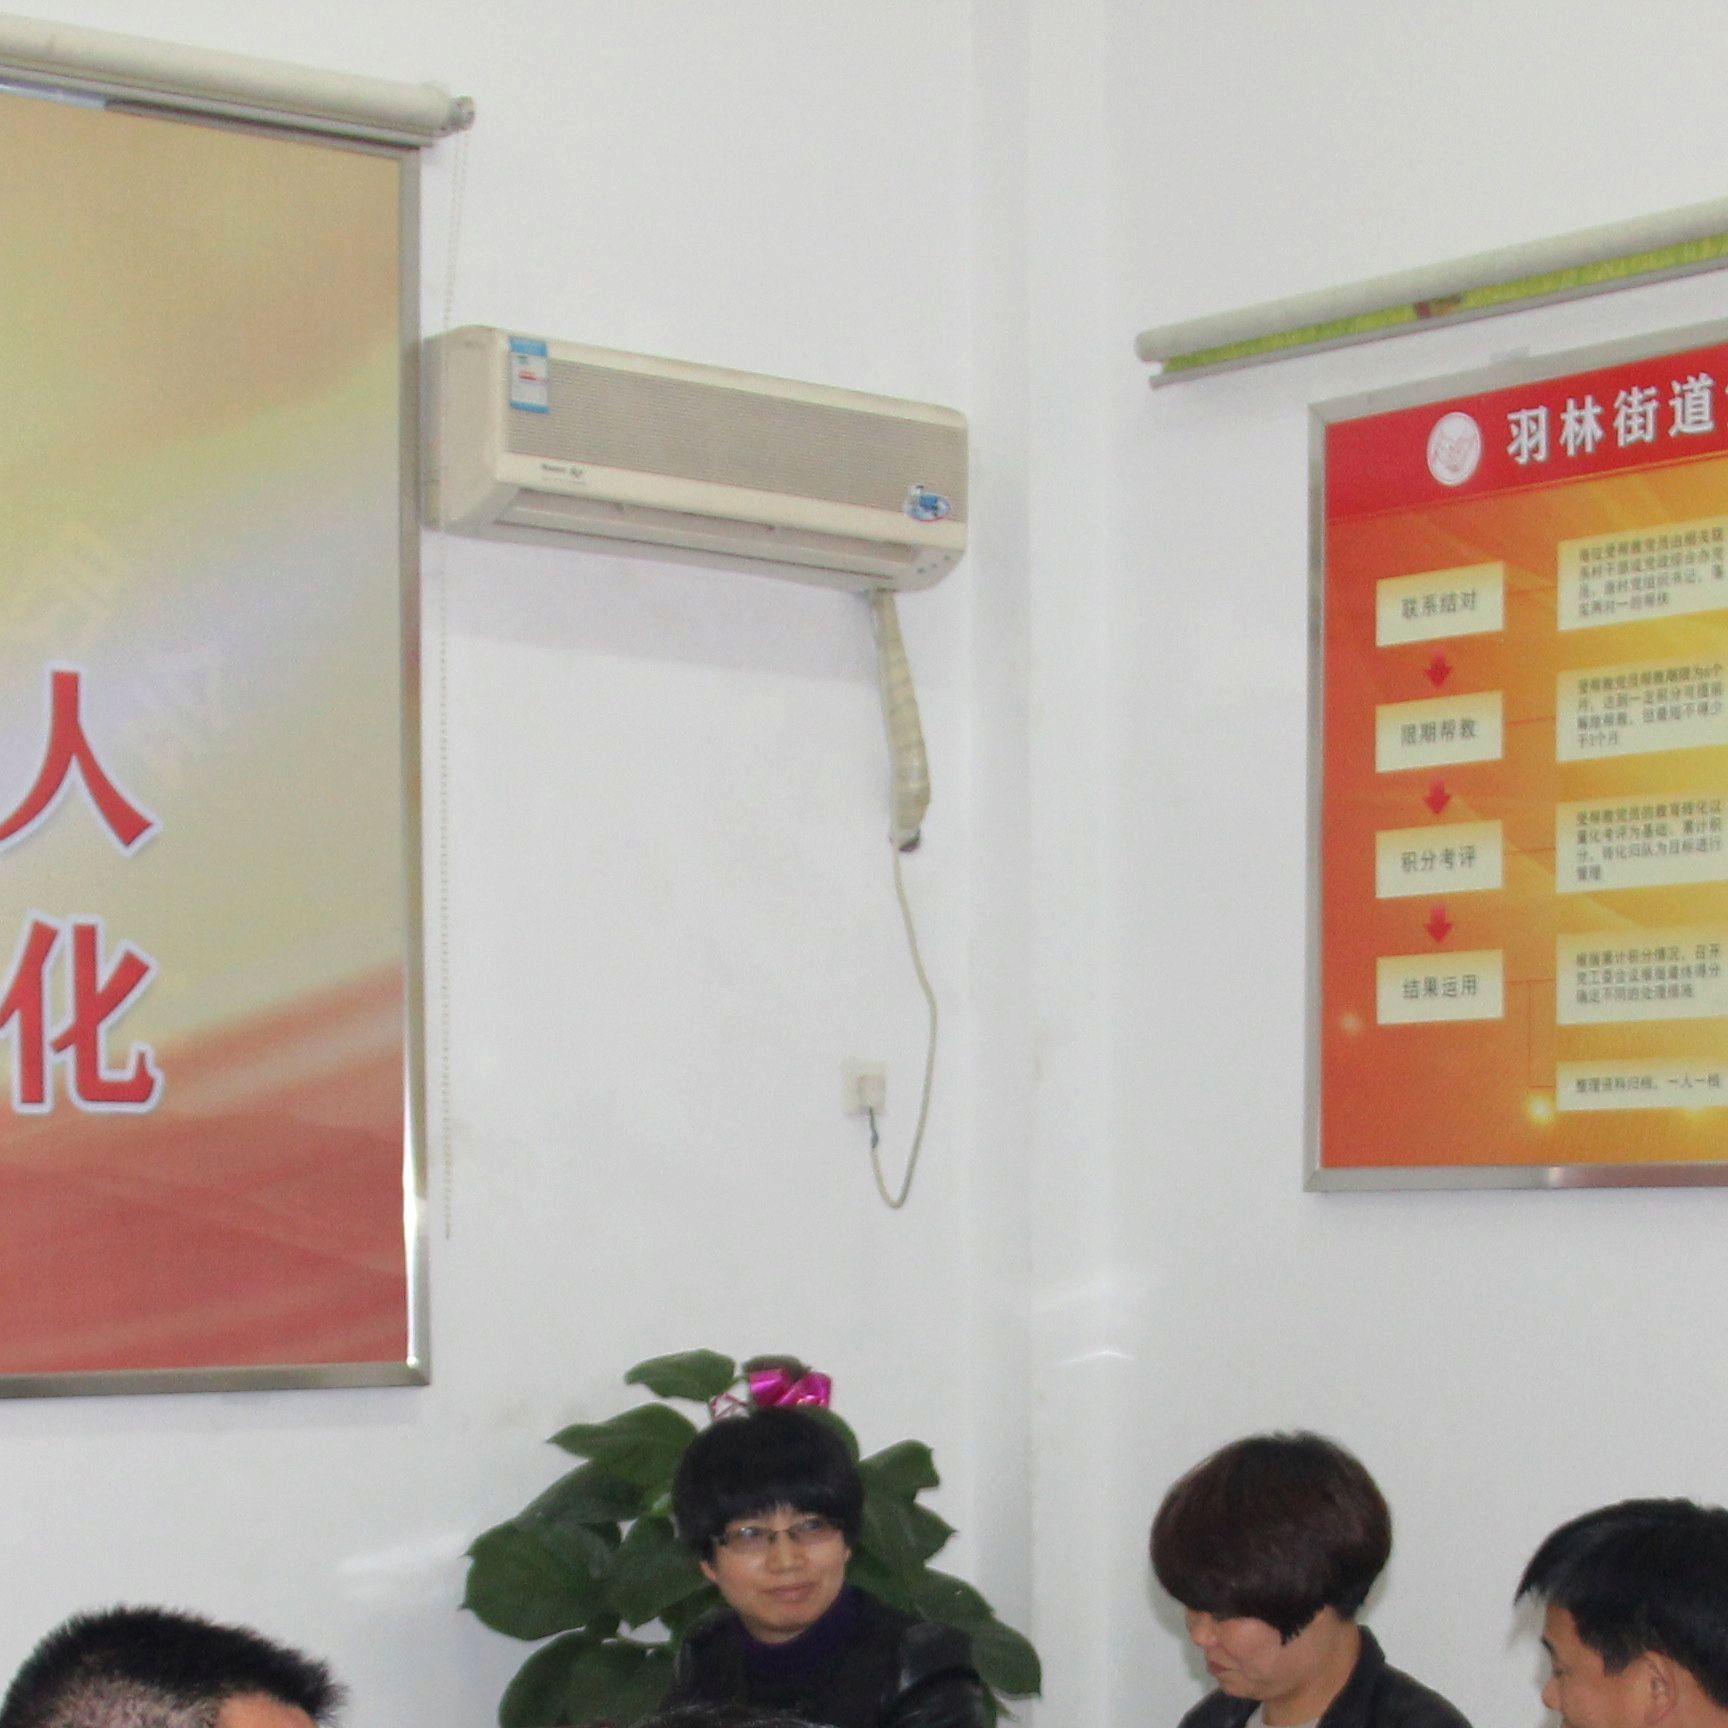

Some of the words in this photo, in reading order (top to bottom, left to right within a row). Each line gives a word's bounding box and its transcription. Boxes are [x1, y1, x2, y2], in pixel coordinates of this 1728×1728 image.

[1401, 591, 1477, 619] 联系结对
[1400, 719, 1477, 747] 限期帮教
[1401, 846, 1477, 872] 积分考评
[1403, 974, 1478, 1000] 结果运用
